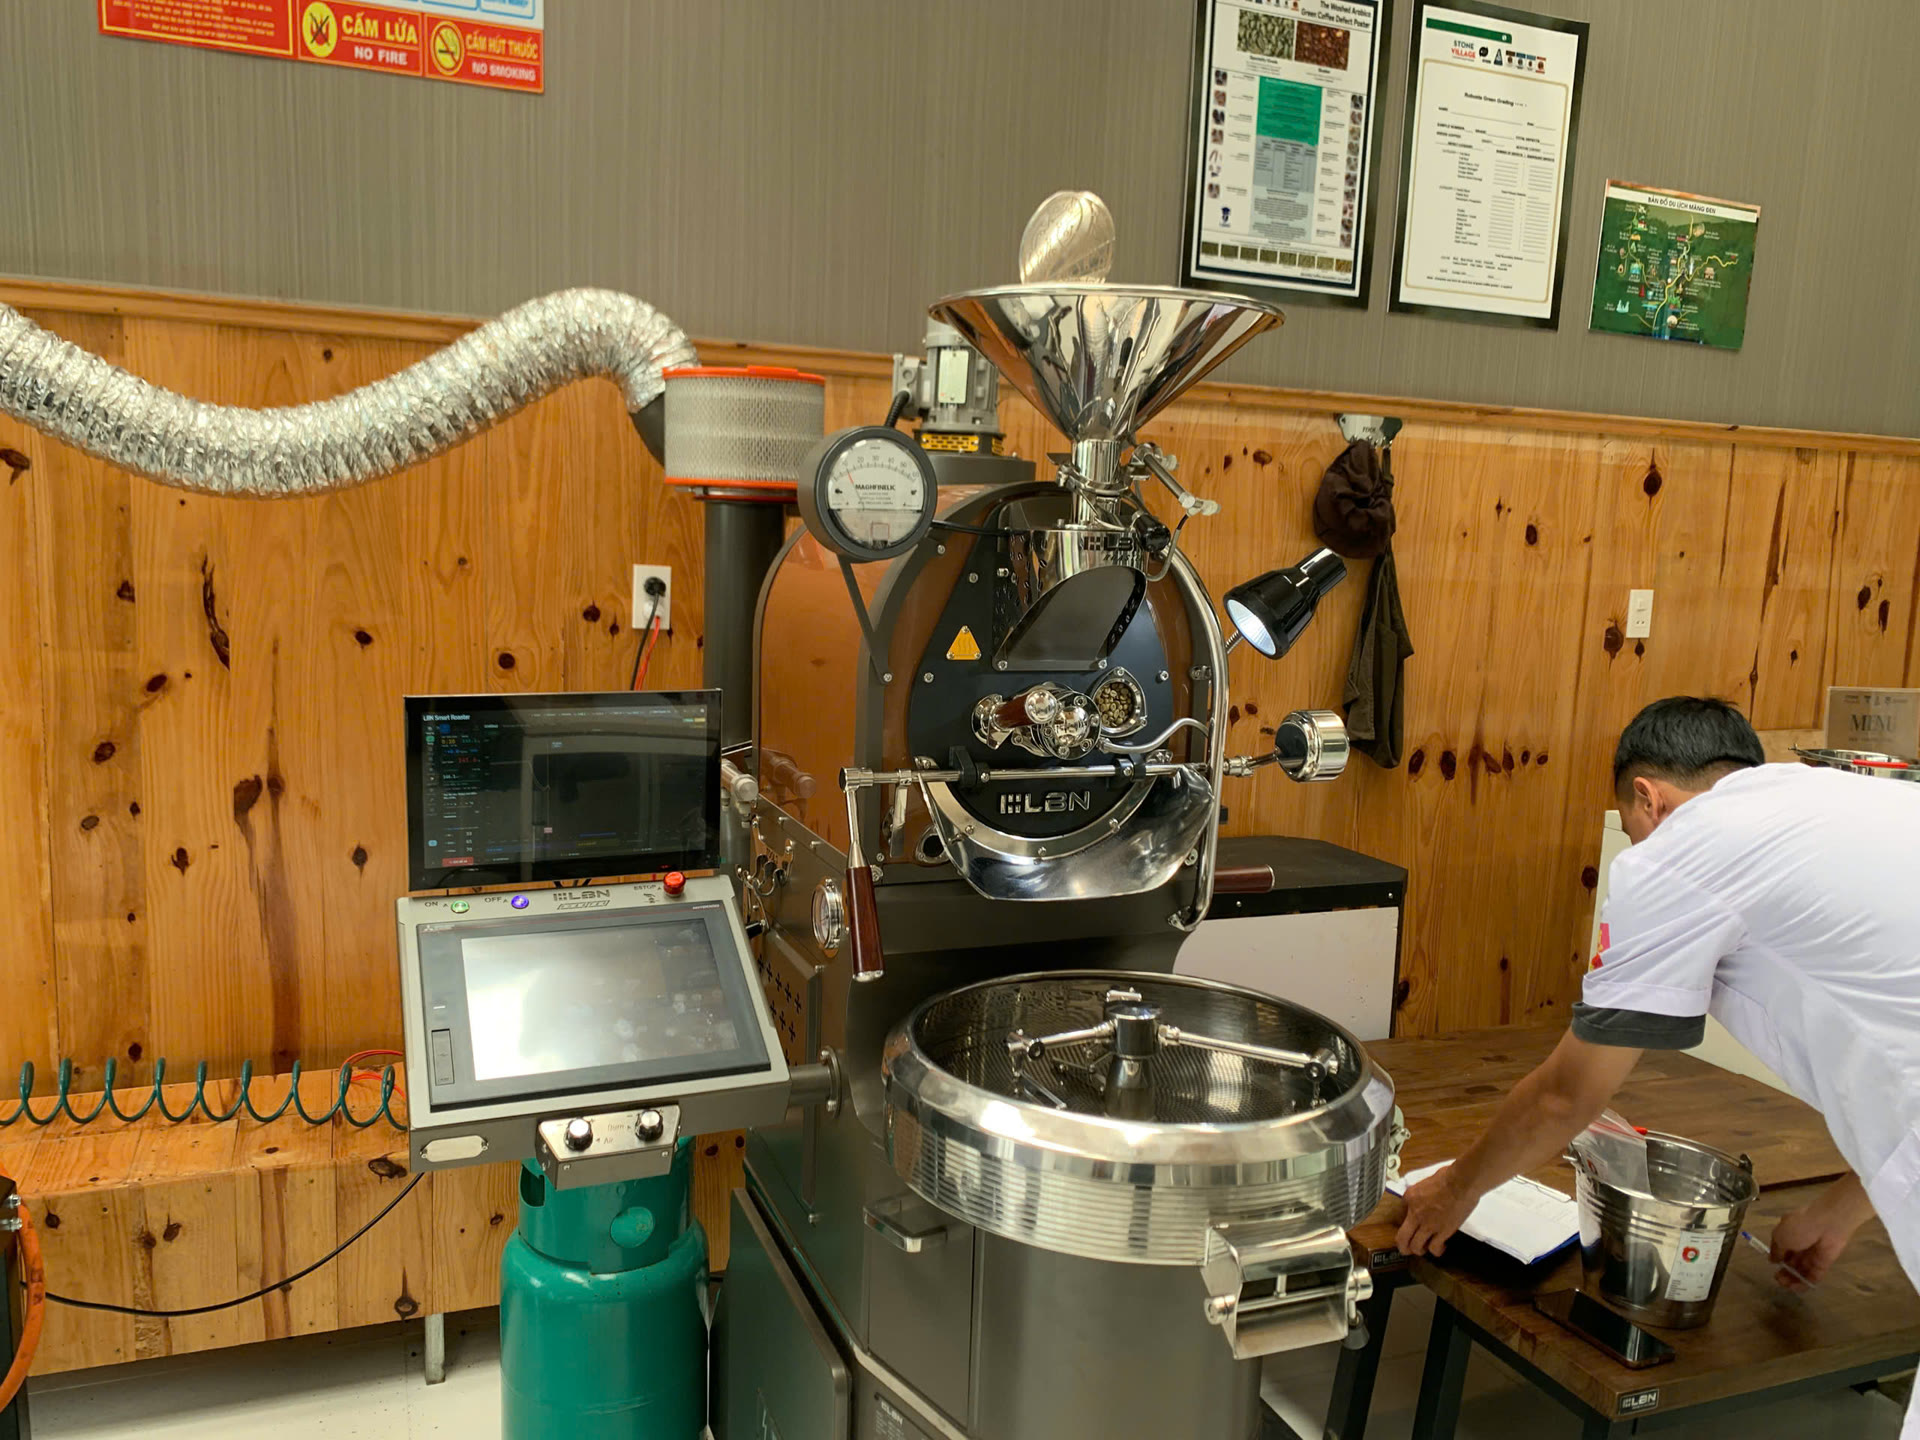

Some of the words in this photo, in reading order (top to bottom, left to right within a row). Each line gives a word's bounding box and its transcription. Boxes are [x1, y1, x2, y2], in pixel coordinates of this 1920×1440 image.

[1320, 0, 1330, 9] The
[1331, 3, 1351, 14] Washed
[1301, 8, 1317, 18] Green
[1318, 11, 1335, 21] Coffee
[1336, 15, 1353, 26] Defect
[1354, 19, 1370, 28] Poster
[342, 12, 379, 38] CẤM
[385, 18, 418, 44] LỬA
[466, 30, 486, 50] CẤM
[488, 34, 506, 54] HÚT
[508, 36, 539, 59] THUỐC
[1453, 40, 1474, 50] STONE
[354, 46, 374, 60] NO
[378, 49, 408, 65] FIRE
[1452, 48, 1476, 59] VILLAGE
[472, 61, 487, 75] NO
[489, 64, 536, 82] SMOKING
[450, 713, 470, 721] Roaster
[424, 901, 438, 909] ON
[484, 896, 502, 904] OFF
